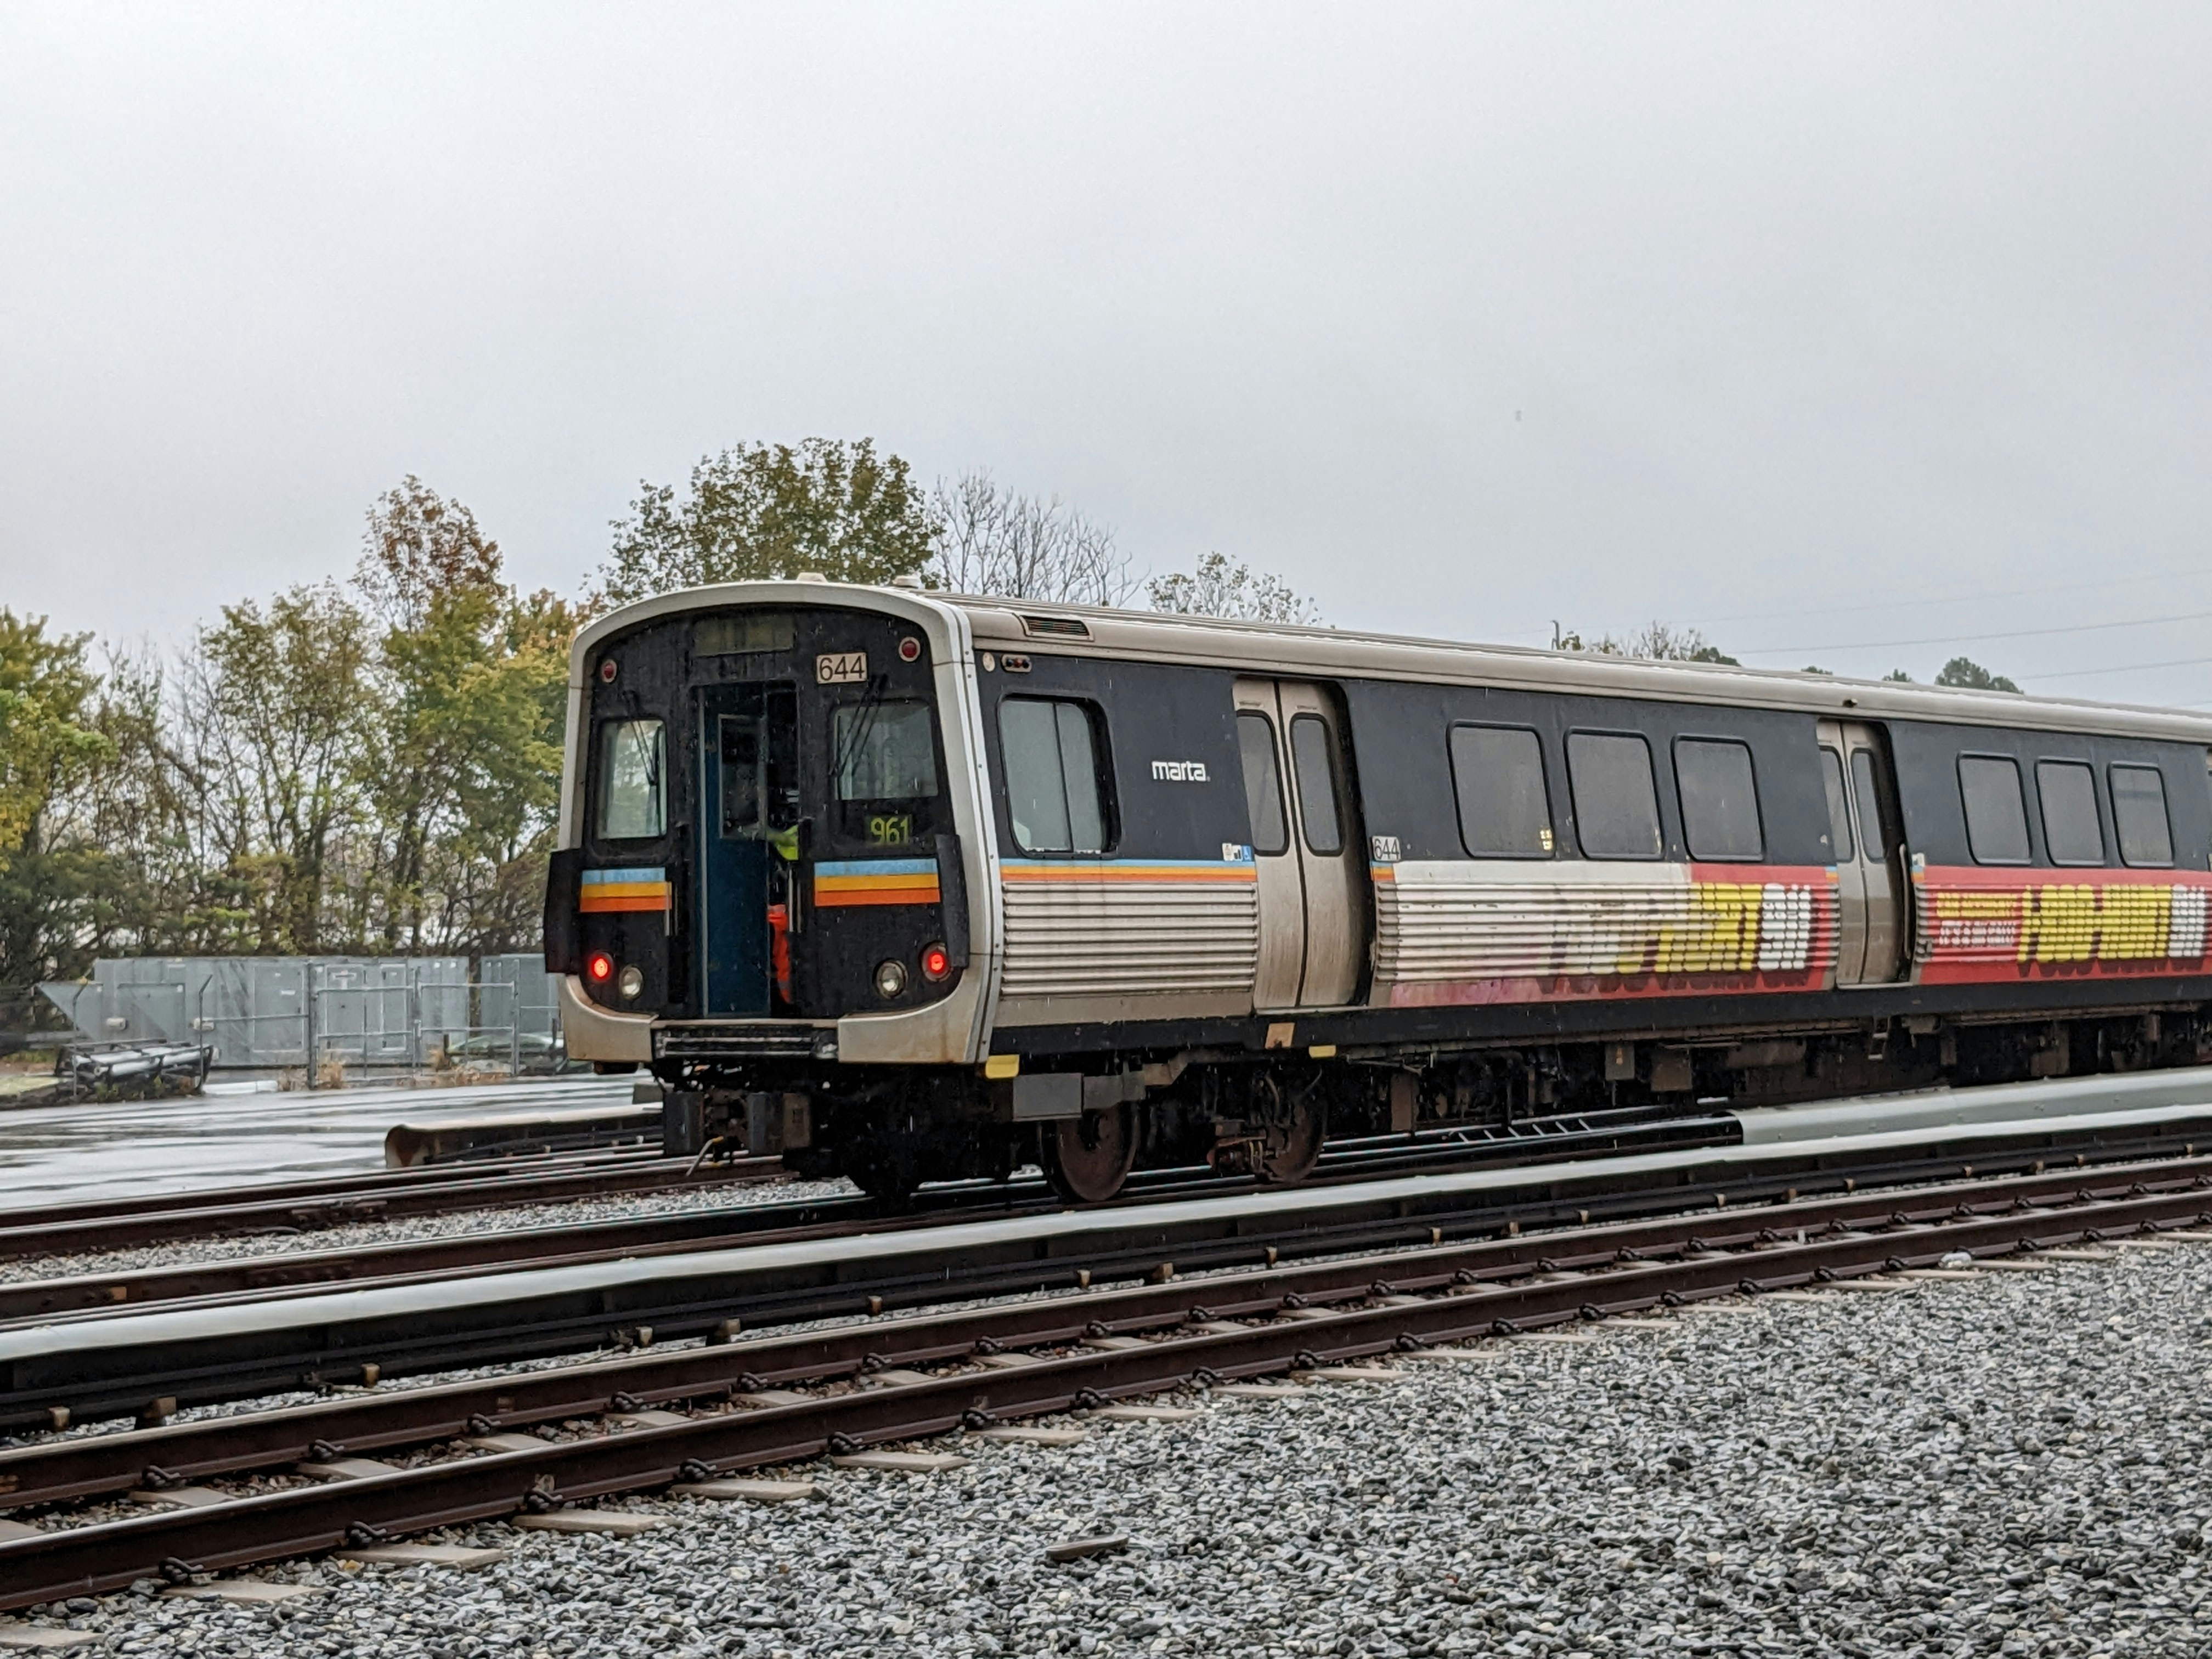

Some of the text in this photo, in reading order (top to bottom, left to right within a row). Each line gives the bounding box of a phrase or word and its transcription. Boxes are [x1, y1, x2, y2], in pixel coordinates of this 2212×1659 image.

[819, 656, 865, 681] 644
[1152, 760, 1206, 782] marta
[870, 816, 909, 845] 961
[1374, 838, 1399, 860] 644
